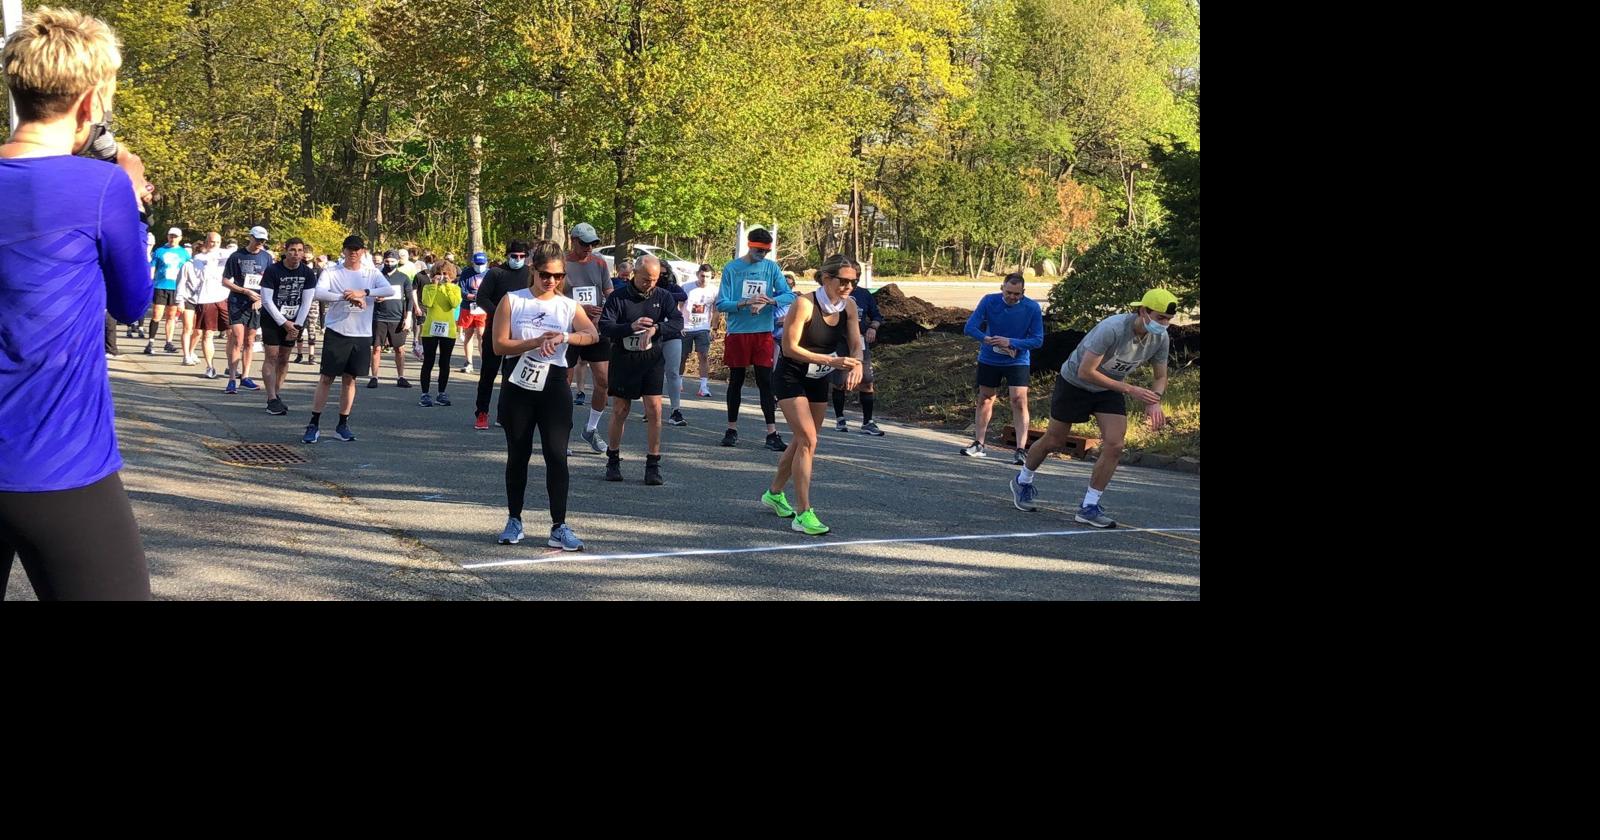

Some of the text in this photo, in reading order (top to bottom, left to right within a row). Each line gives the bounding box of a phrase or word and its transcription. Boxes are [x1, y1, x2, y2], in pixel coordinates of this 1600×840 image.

[747, 284, 761, 294] 774
[578, 291, 593, 302] 515
[434, 324, 446, 334] 776
[520, 366, 540, 383] 671
